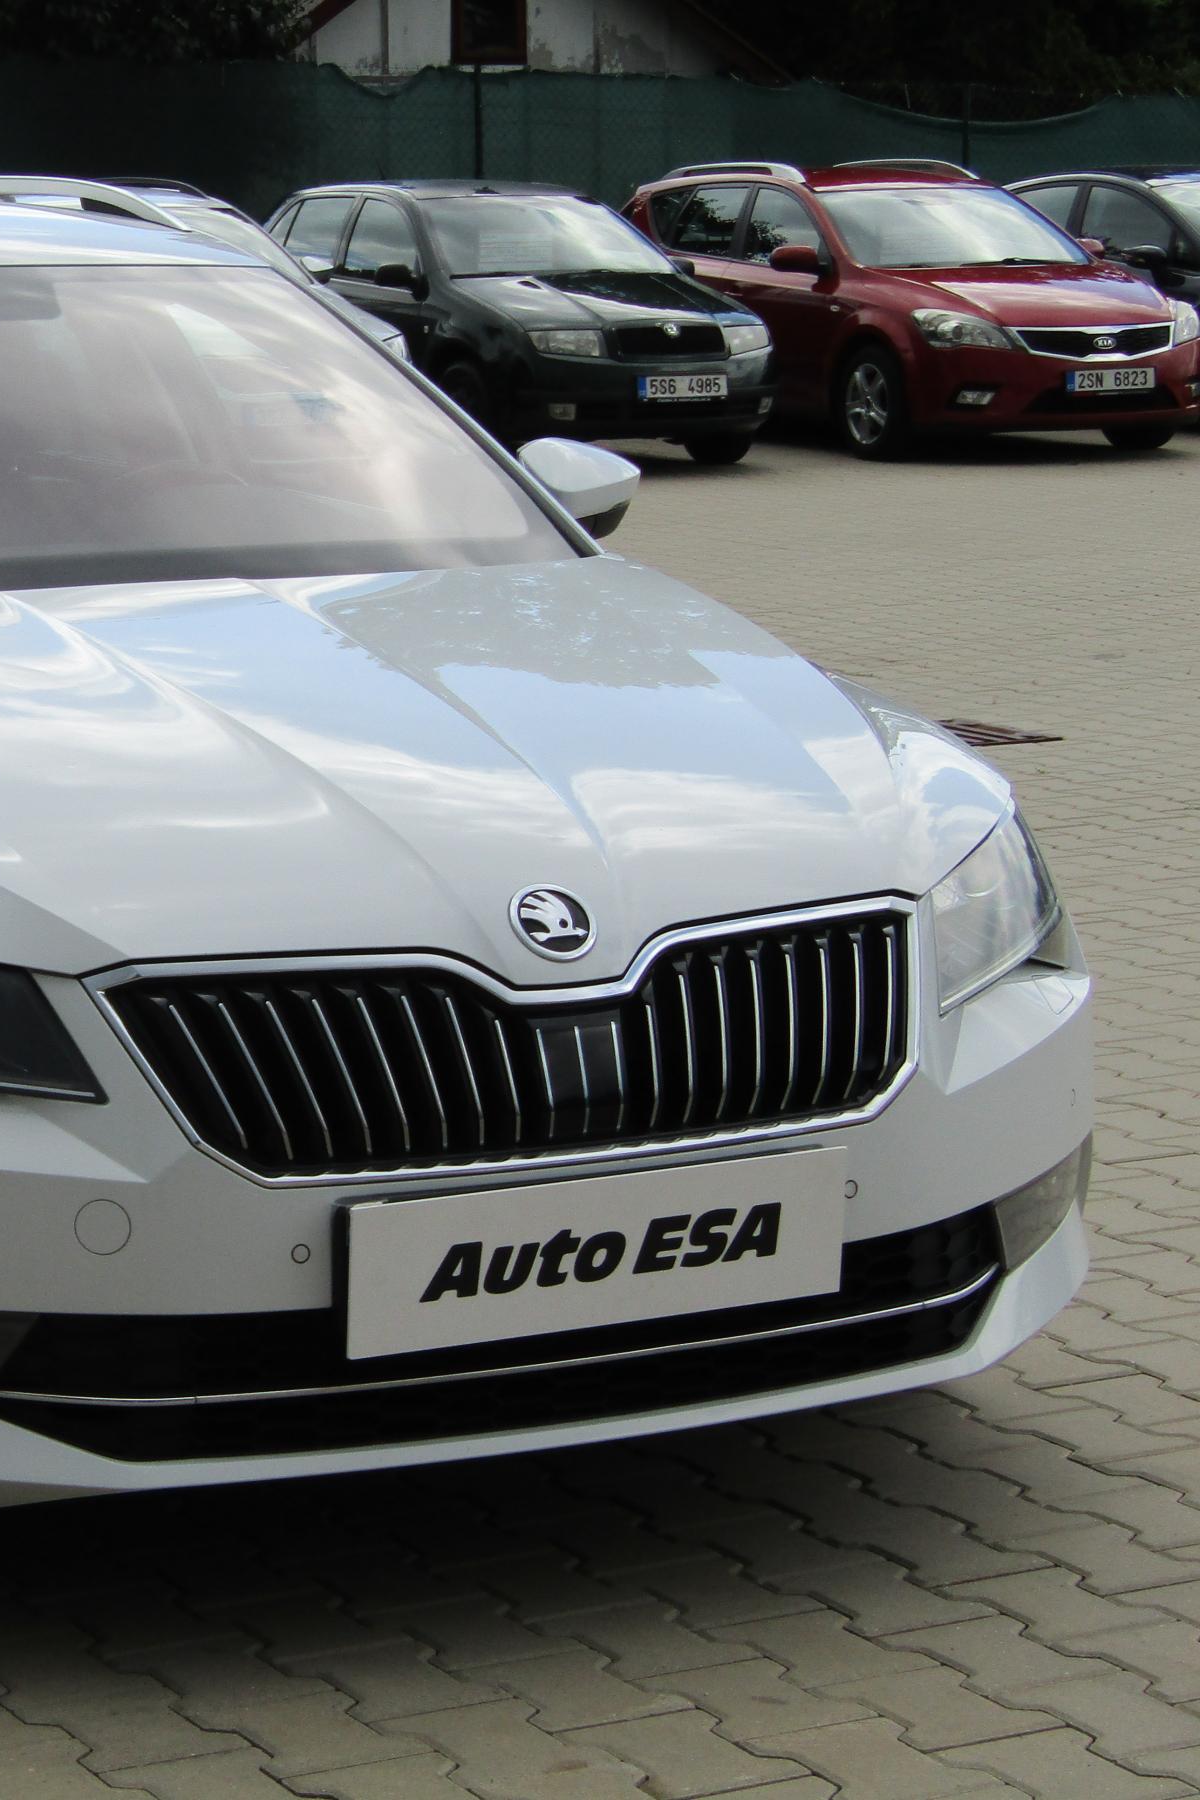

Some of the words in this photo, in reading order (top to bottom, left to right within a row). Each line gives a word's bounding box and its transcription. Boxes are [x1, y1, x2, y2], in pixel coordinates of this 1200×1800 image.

[649, 378, 677, 395] 5S6
[687, 377, 721, 393] 4985
[1078, 372, 1104, 389] 2SN
[1114, 370, 1148, 387] 6823
[419, 1229, 627, 1303] Auto
[633, 1202, 782, 1275] ESA
